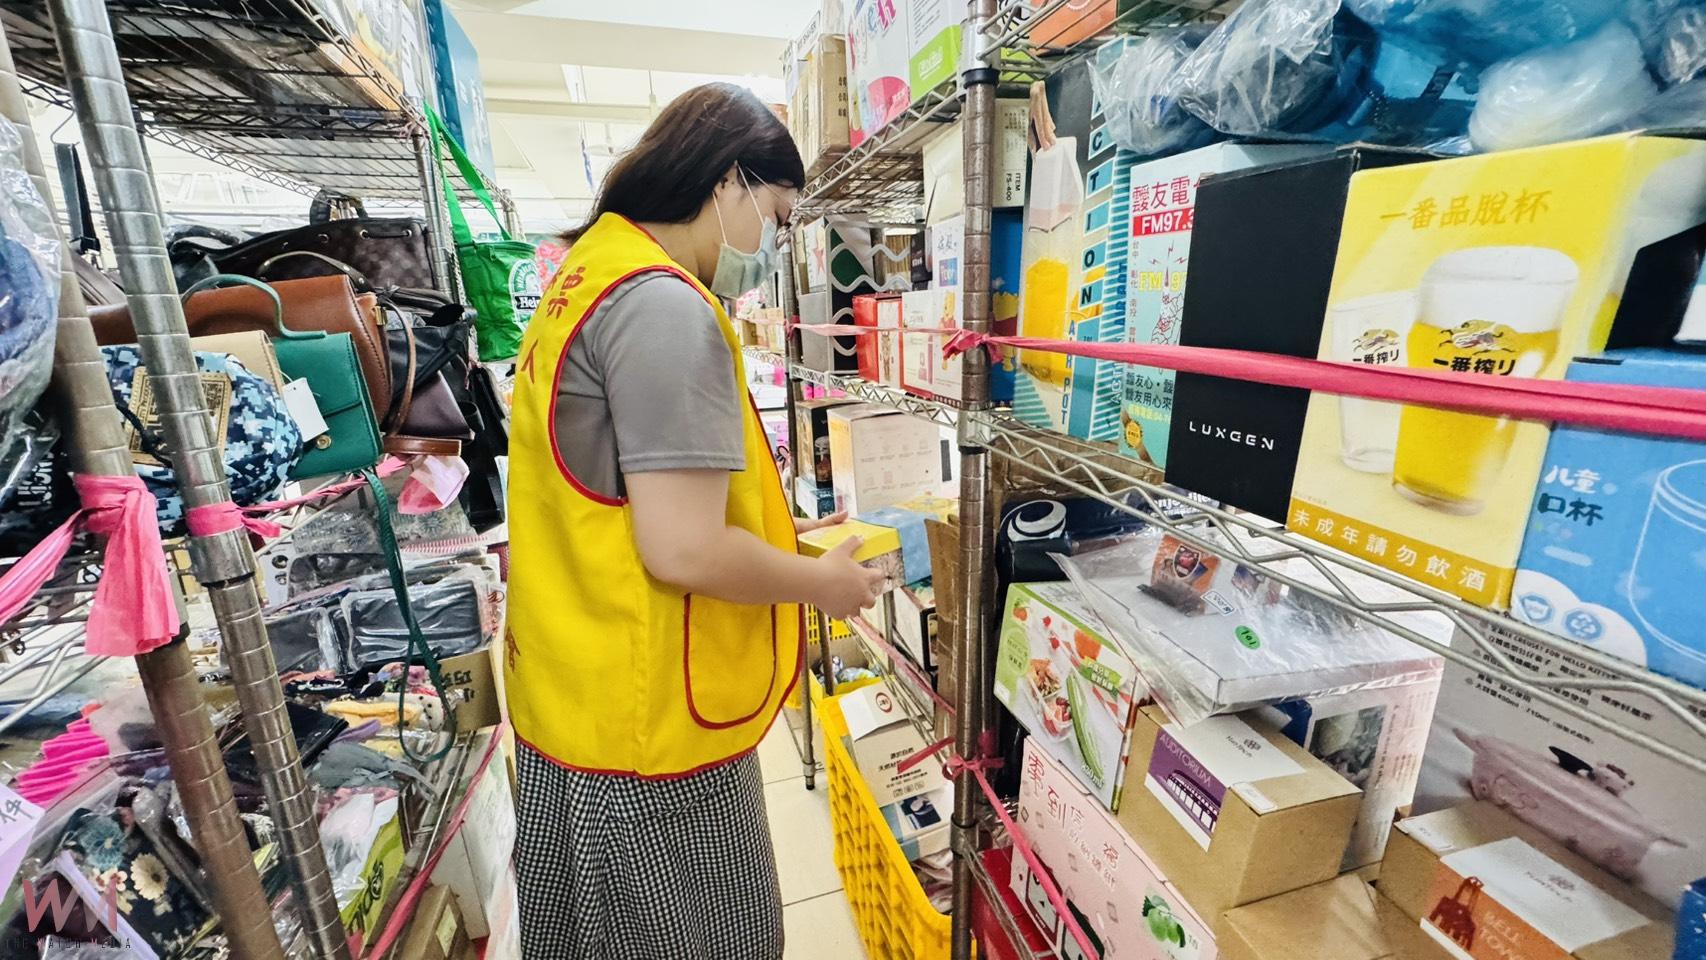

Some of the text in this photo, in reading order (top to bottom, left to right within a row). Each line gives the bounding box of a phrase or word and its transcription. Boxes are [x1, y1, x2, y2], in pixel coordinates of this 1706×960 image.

[1132, 175, 1200, 213] 靉友電
[1188, 420, 1275, 451] LUXGEN
[1543, 464, 1601, 494] 儿童
[1537, 492, 1604, 527] 口杯
[1292, 507, 1488, 592] 未成年請勿飲酒
[1159, 732, 1212, 788] AUDITORIUM
